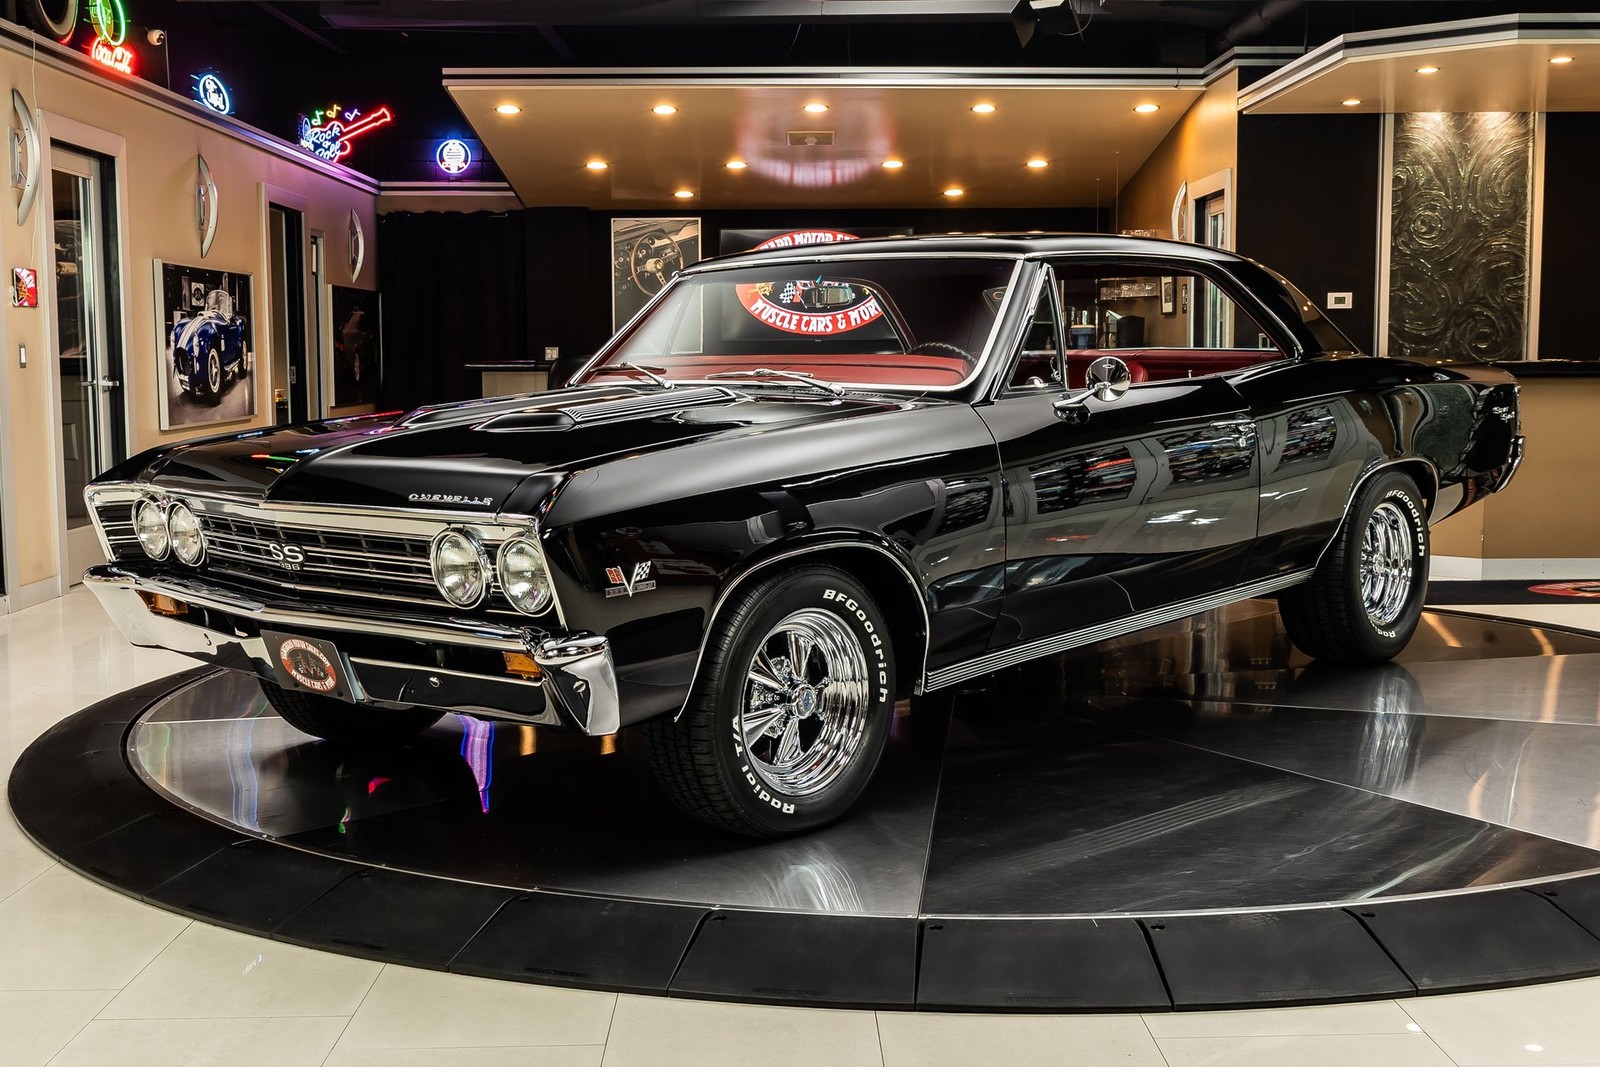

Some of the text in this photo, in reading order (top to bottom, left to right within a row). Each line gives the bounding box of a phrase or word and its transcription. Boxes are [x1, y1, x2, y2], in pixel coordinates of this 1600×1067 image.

[306, 123, 341, 144] Rock
[750, 298, 798, 331] MUSCLE
[801, 315, 833, 333] CARS
[836, 313, 846, 330] &
[408, 493, 493, 506] CHEVELLE
[1384, 489, 1425, 557] BFGoodrich
[270, 543, 304, 562] SS
[823, 589, 888, 703] BFGoodrich
[732, 715, 795, 814] Radial T/A
